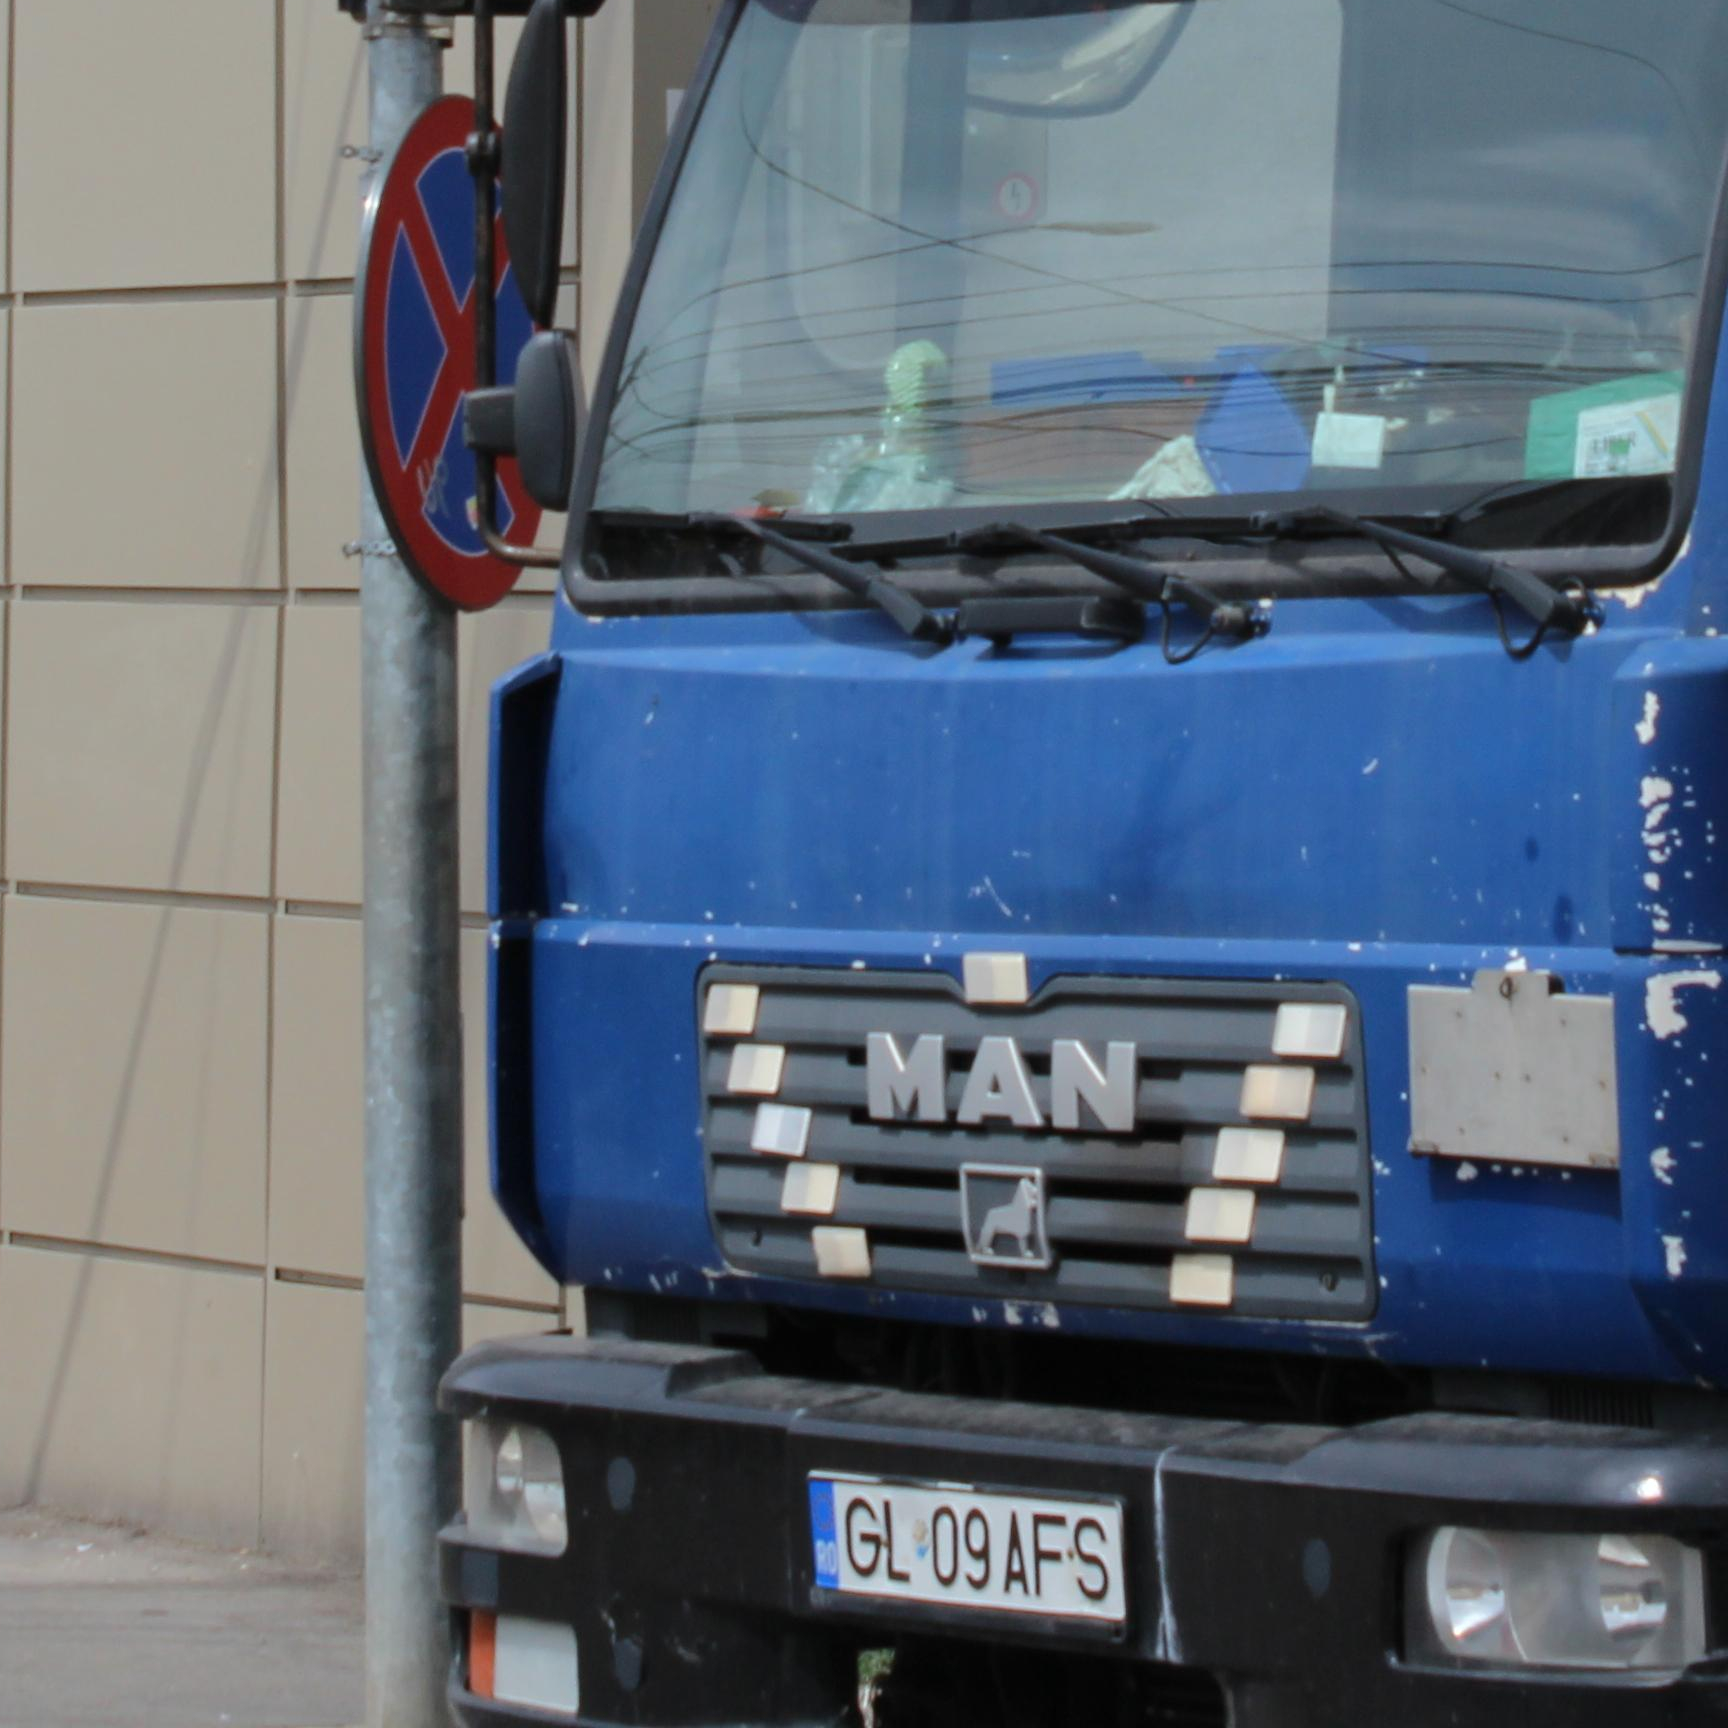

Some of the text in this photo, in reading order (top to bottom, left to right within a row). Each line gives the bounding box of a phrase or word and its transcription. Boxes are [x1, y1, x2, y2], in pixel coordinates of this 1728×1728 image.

[866, 1032, 1137, 1132] MAN
[845, 1496, 1110, 1601] GL 09 AFS
